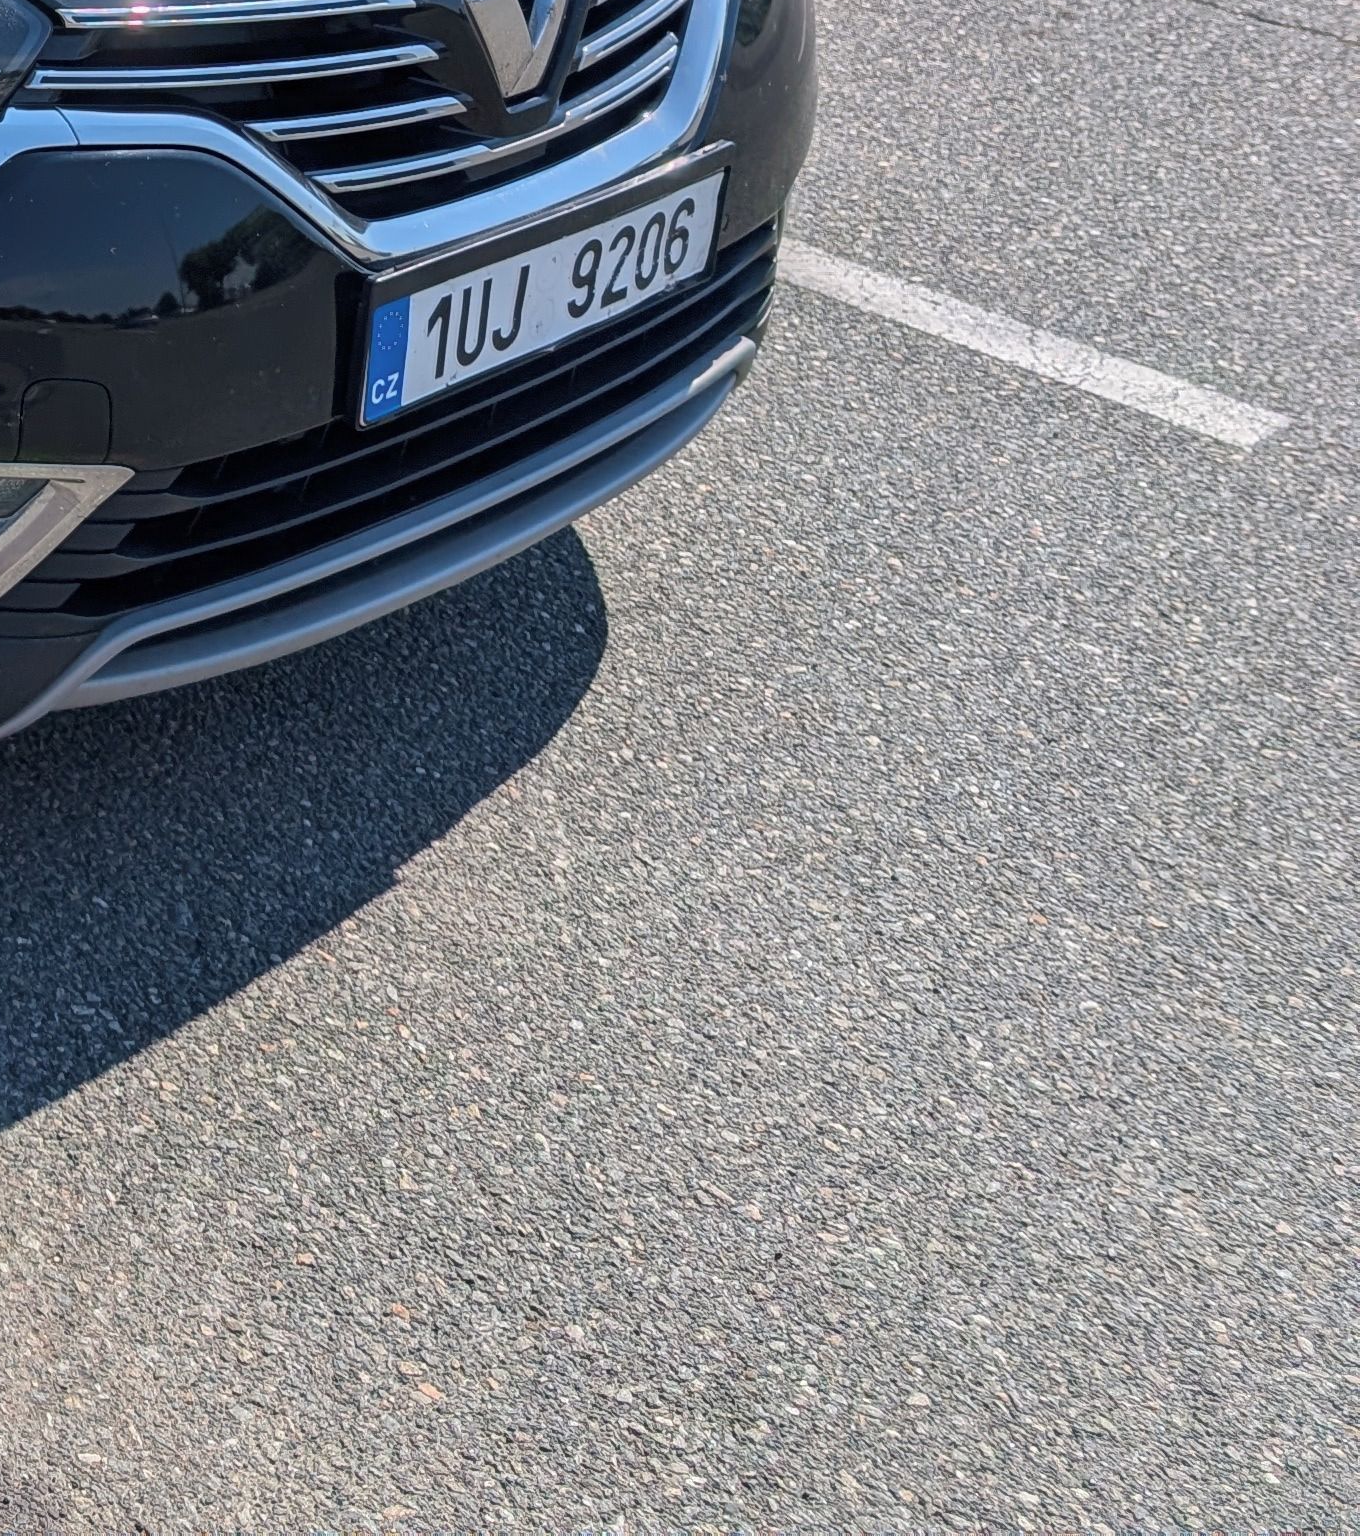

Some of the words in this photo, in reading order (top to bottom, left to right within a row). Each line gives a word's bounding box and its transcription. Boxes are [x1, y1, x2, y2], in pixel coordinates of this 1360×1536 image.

[427, 264, 530, 379] 1UJ
[567, 197, 695, 319] 9206
[371, 377, 399, 405] CZ
